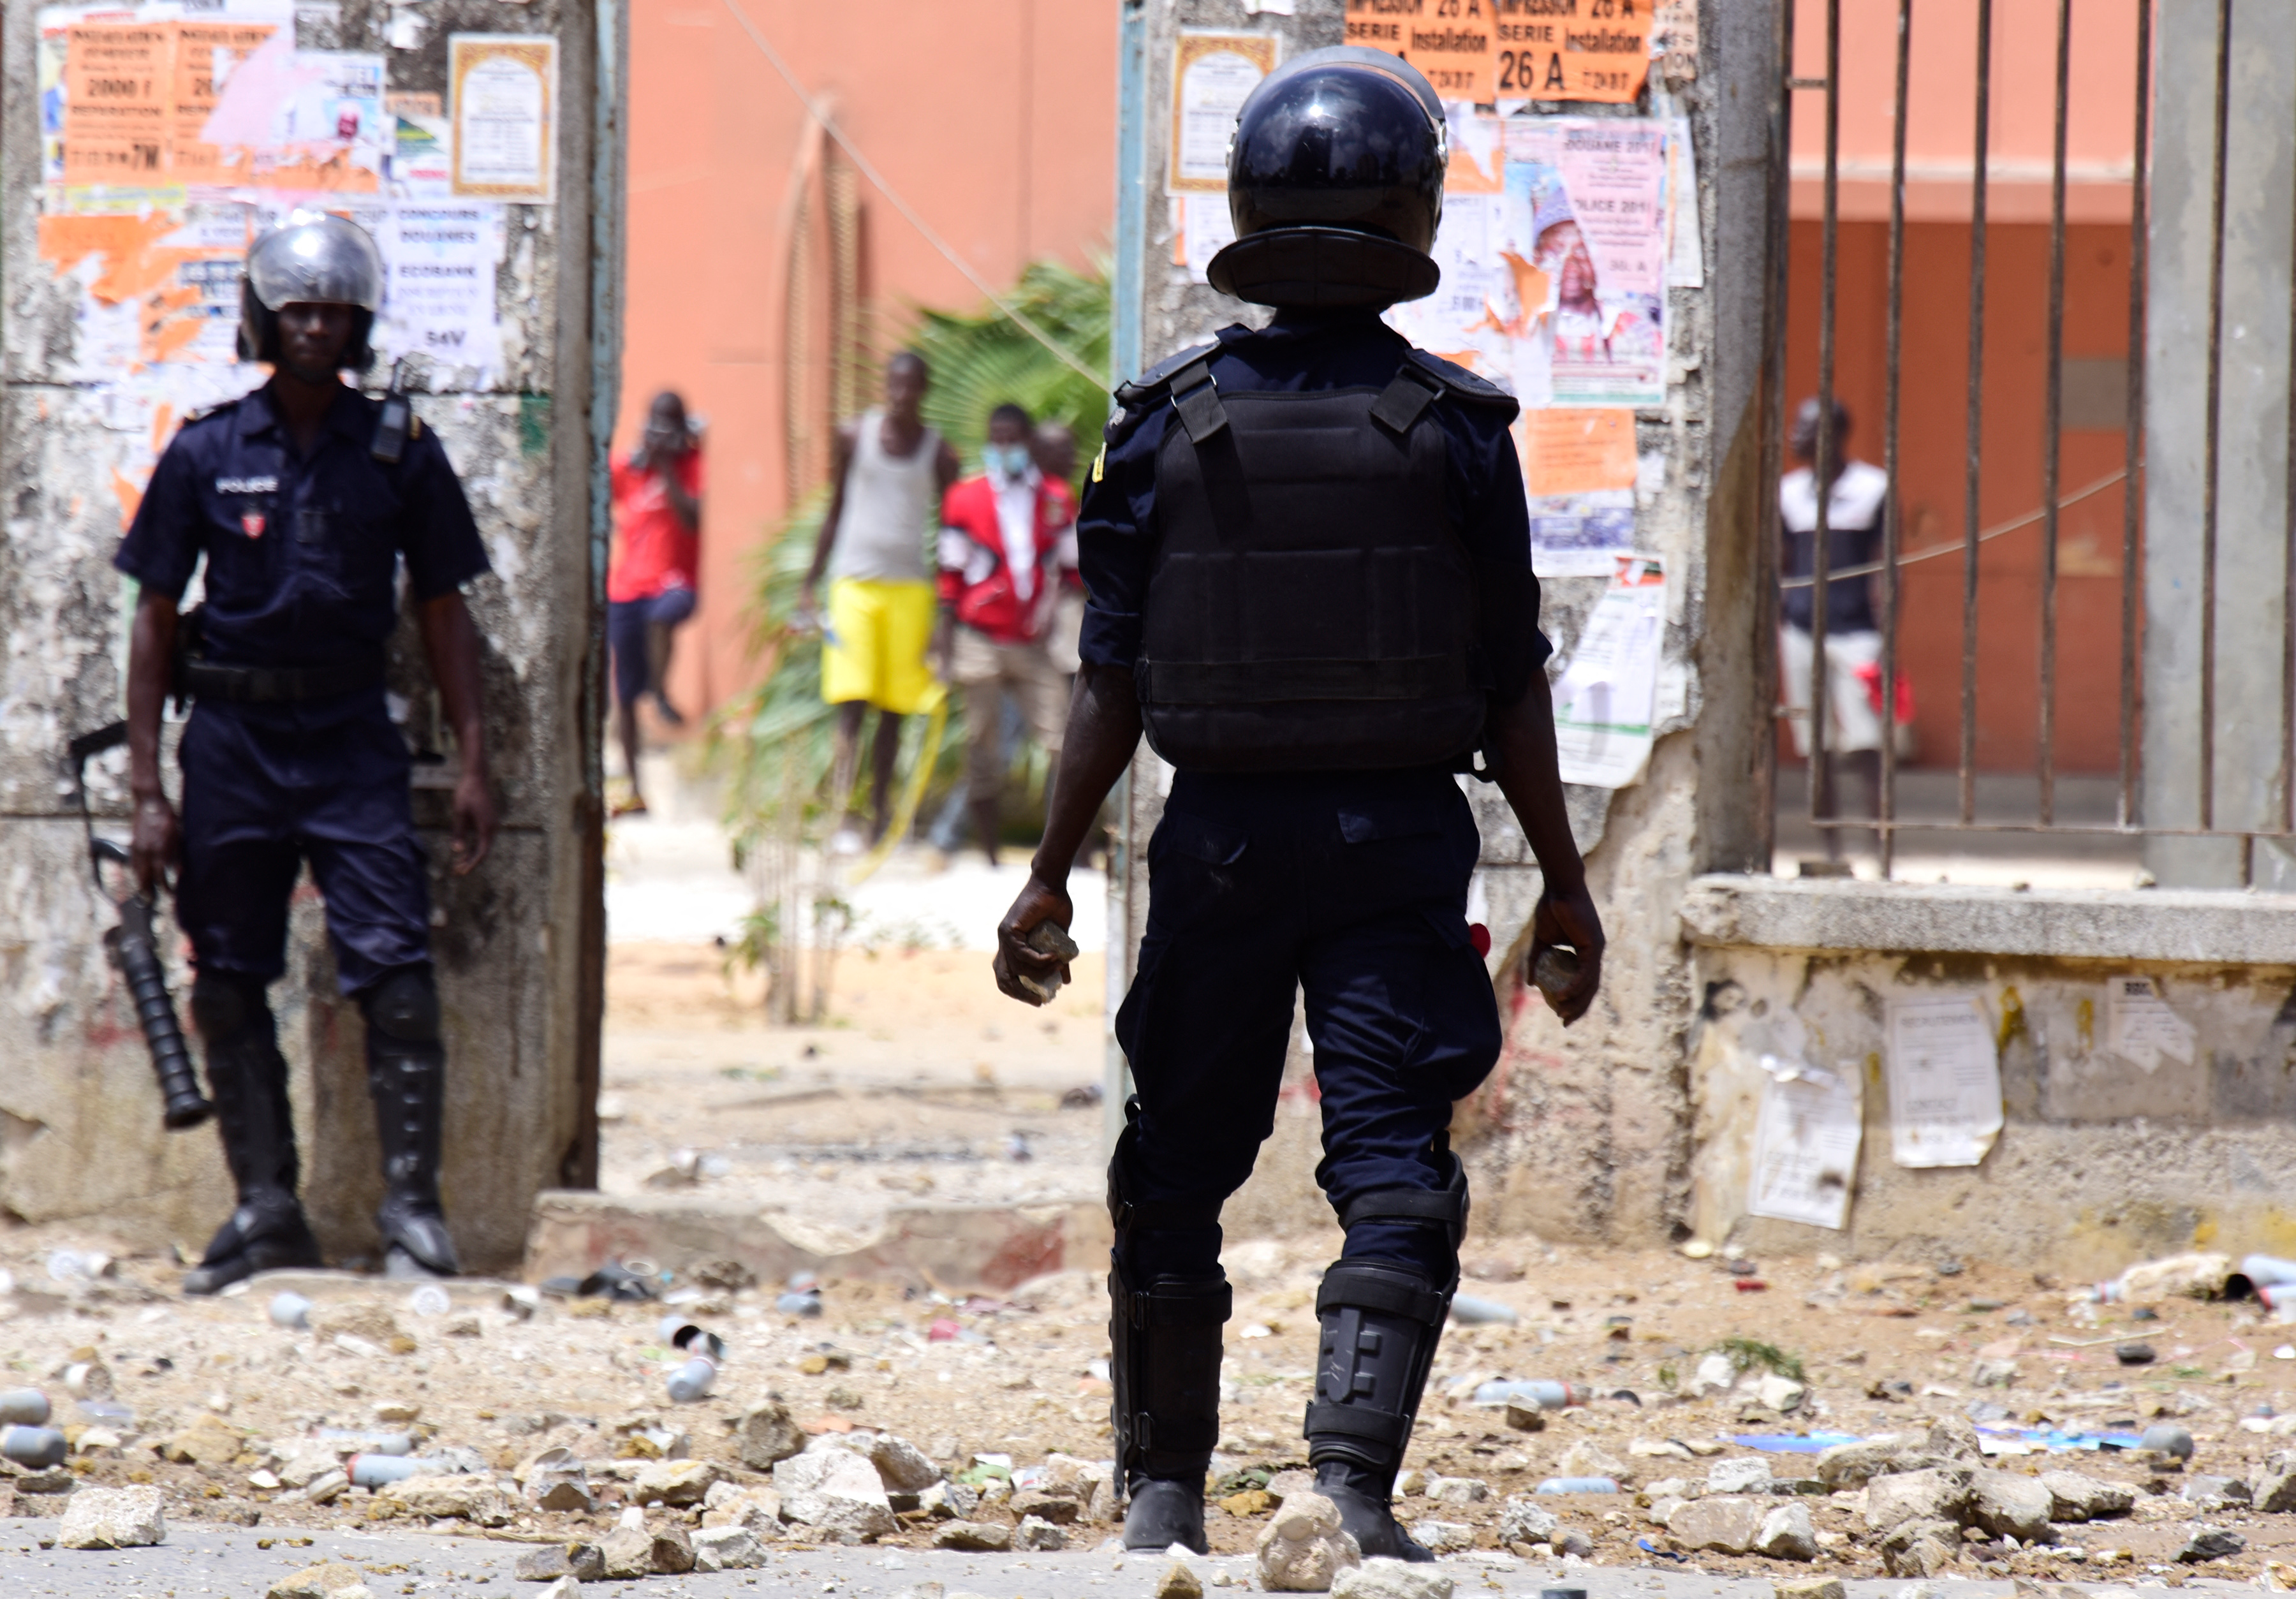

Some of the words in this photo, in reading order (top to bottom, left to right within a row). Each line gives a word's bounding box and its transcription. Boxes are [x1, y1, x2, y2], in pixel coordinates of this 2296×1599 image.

[1346, 22, 1401, 40] SERIE
[1411, 27, 1488, 53] Installation
[1498, 24, 1554, 42] SERIE
[1565, 27, 1642, 53] Installation
[1499, 50, 1533, 91] 26
[1545, 51, 1566, 91] A
[89, 78, 138, 98] 2000
[1575, 198, 1614, 212] OLICE
[399, 209, 478, 221] CONCOURS
[400, 231, 477, 244] DOUANES
[399, 265, 477, 278] ECOBANK
[216, 476, 278, 494] POLICE
